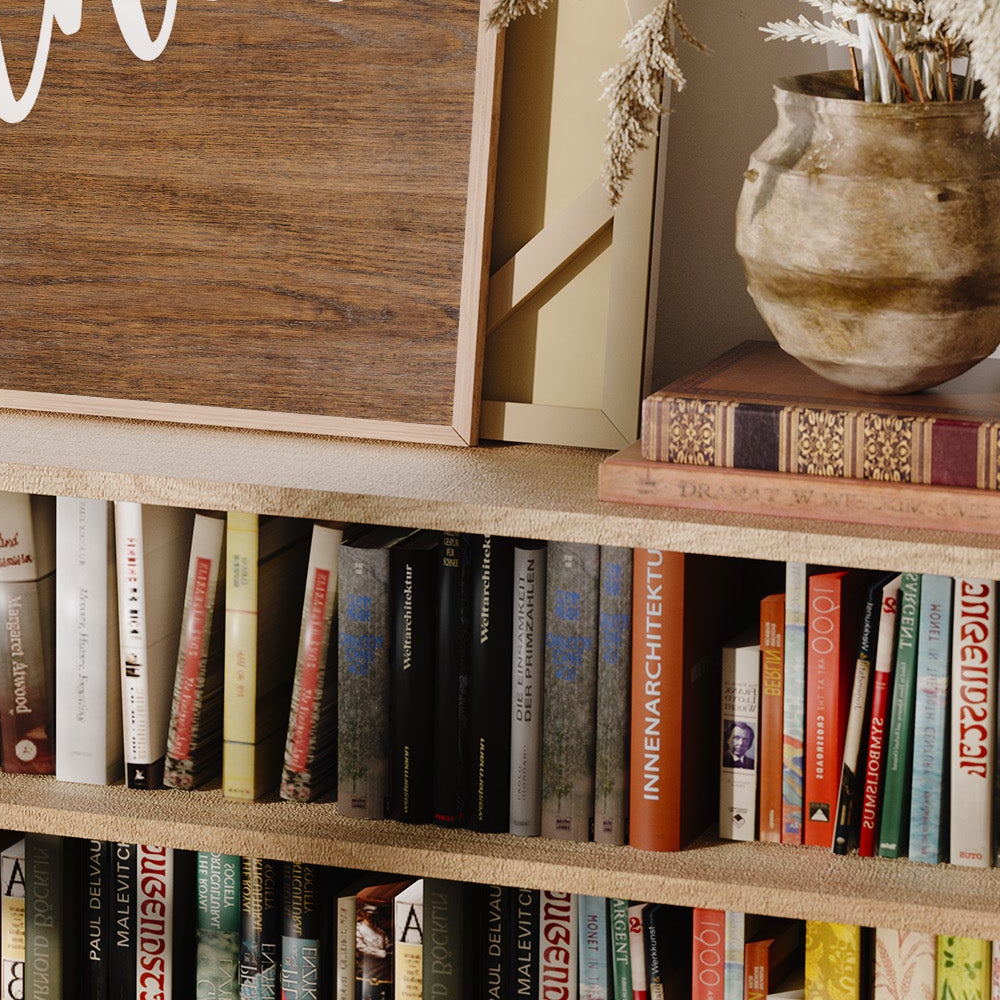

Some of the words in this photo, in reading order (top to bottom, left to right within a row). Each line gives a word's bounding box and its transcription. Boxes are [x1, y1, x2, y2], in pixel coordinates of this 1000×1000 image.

[5, 595, 25, 656] Margaret
[403, 563, 413, 670] Weltarchitektur
[525, 559, 535, 678] PRIMZAHLEN
[12, 660, 32, 714] Atwood
[524, 685, 534, 722] DER
[643, 550, 663, 801] INNENARCHITEKTU
[90, 841, 102, 909] DELVAU
[90, 915, 101, 961] PAUL
[488, 885, 501, 957] DELVAU
[587, 914, 598, 952] MONET
[612, 899, 629, 965] ARGENT
[650, 926, 660, 974] Werkkunst
[695, 922, 721, 987] 1900
